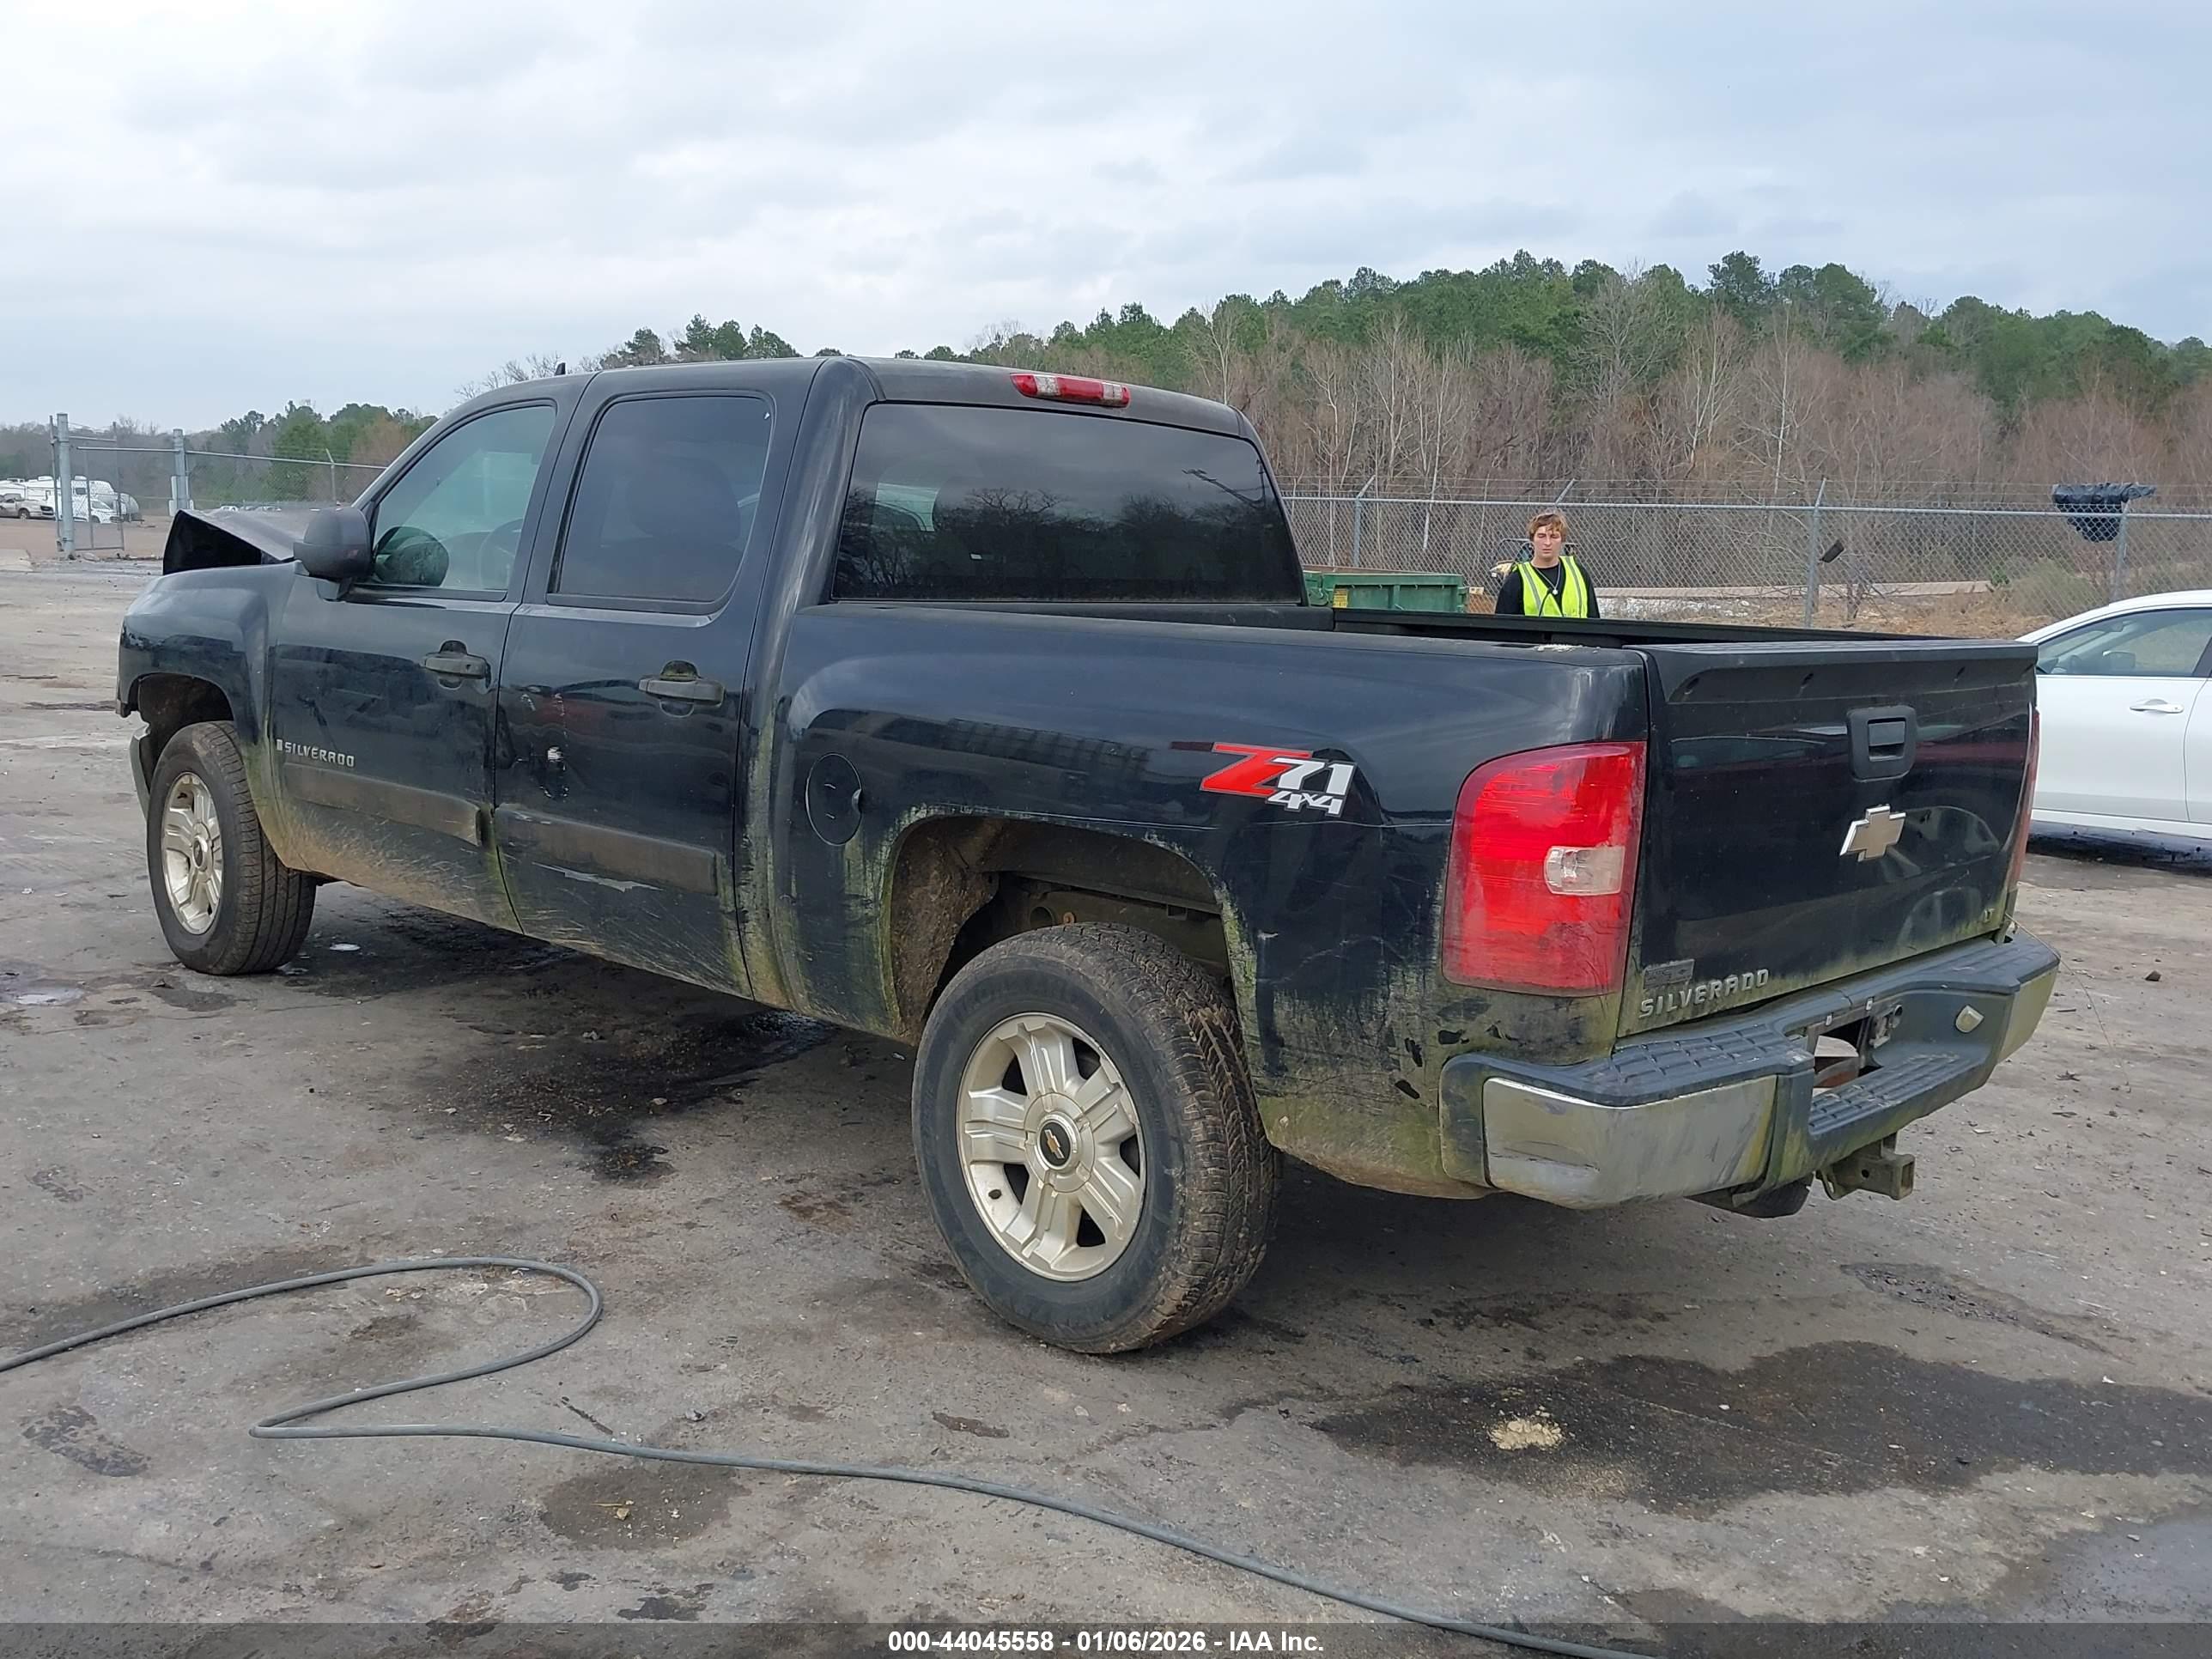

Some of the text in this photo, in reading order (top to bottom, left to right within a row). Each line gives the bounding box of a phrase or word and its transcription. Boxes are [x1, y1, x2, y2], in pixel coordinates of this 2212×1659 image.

[284, 741, 355, 768] SILVERADO
[1200, 742, 1358, 798] Z71
[1638, 968, 1770, 1019] SILVERADO
